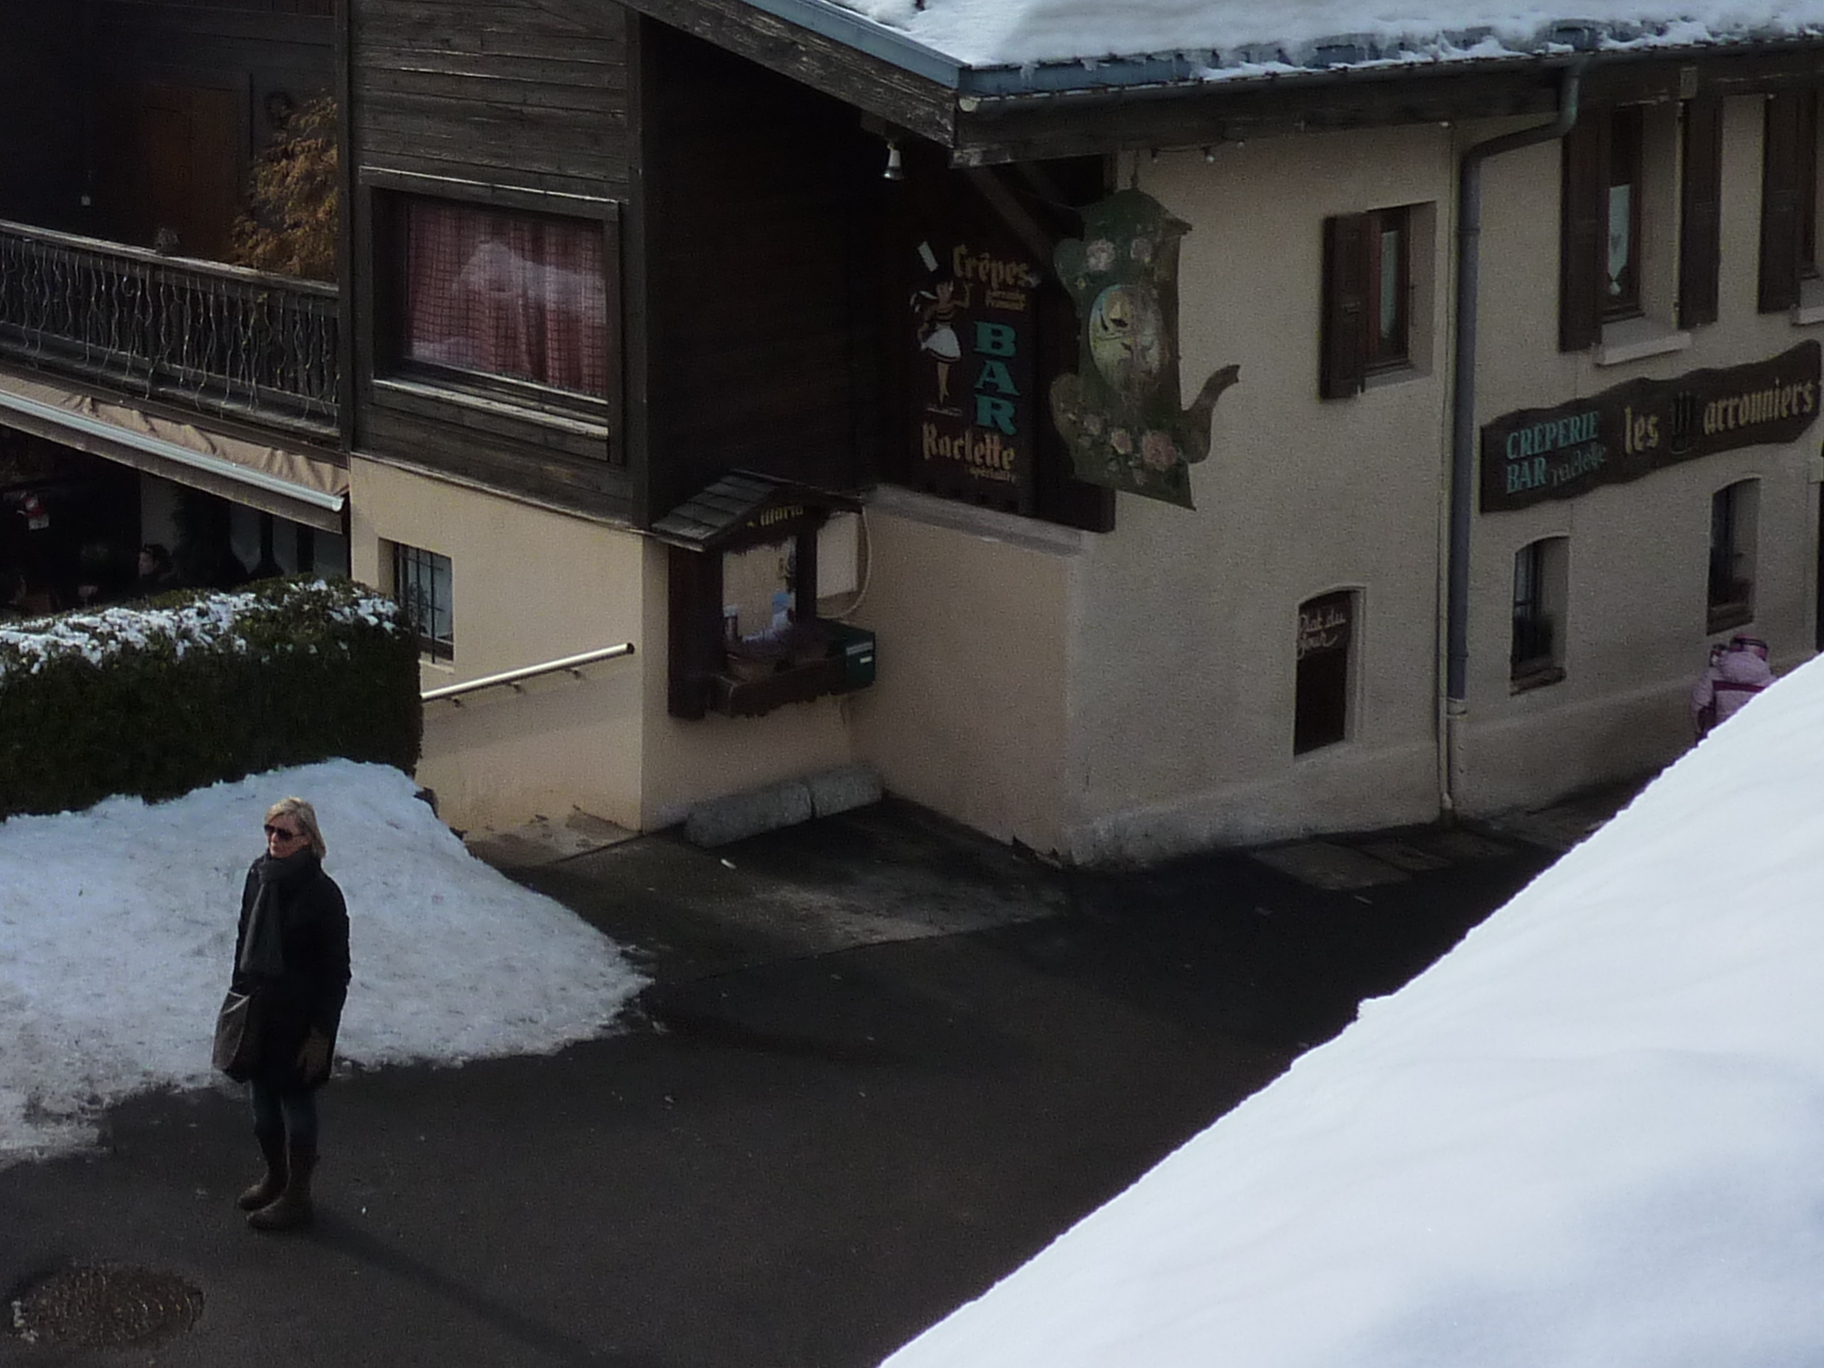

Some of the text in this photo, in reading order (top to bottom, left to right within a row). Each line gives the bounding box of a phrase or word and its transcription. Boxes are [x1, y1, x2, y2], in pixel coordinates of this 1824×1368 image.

[953, 243, 1029, 290] Crêpes
[973, 320, 1021, 436] BAR
[922, 421, 1016, 471] Raclette
[1624, 405, 1659, 454] les
[1506, 457, 1547, 494] BAR
